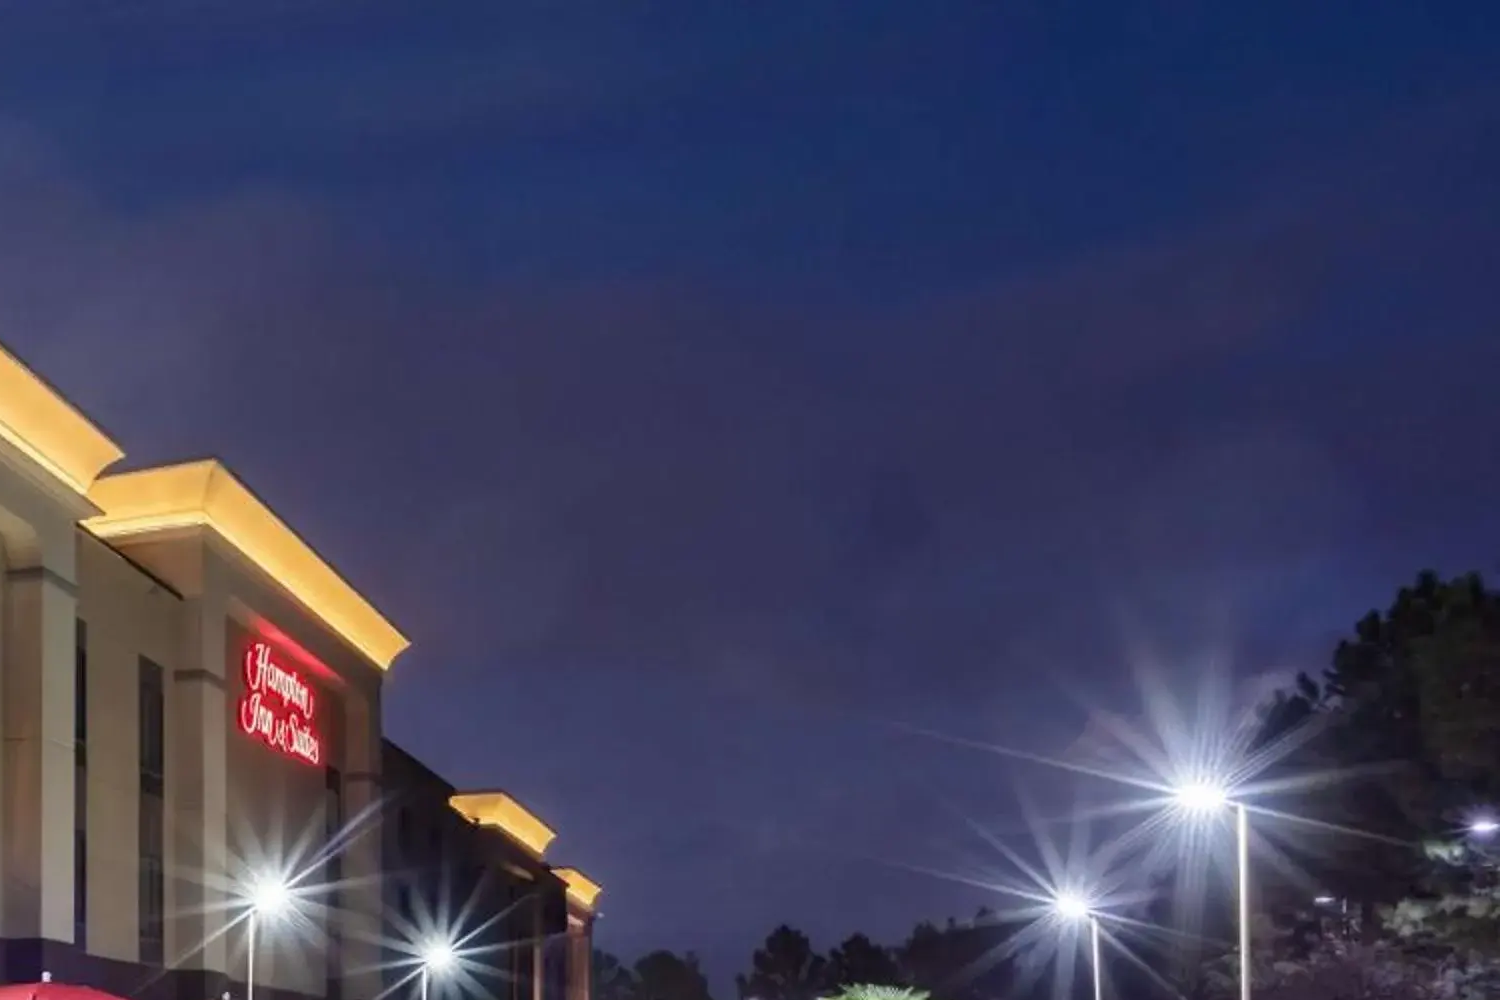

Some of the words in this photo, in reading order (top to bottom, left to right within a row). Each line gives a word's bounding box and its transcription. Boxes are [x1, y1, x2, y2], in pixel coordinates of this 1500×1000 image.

[246, 643, 314, 719] Hampton
[241, 693, 277, 745] Inn
[285, 714, 320, 764] Suites
